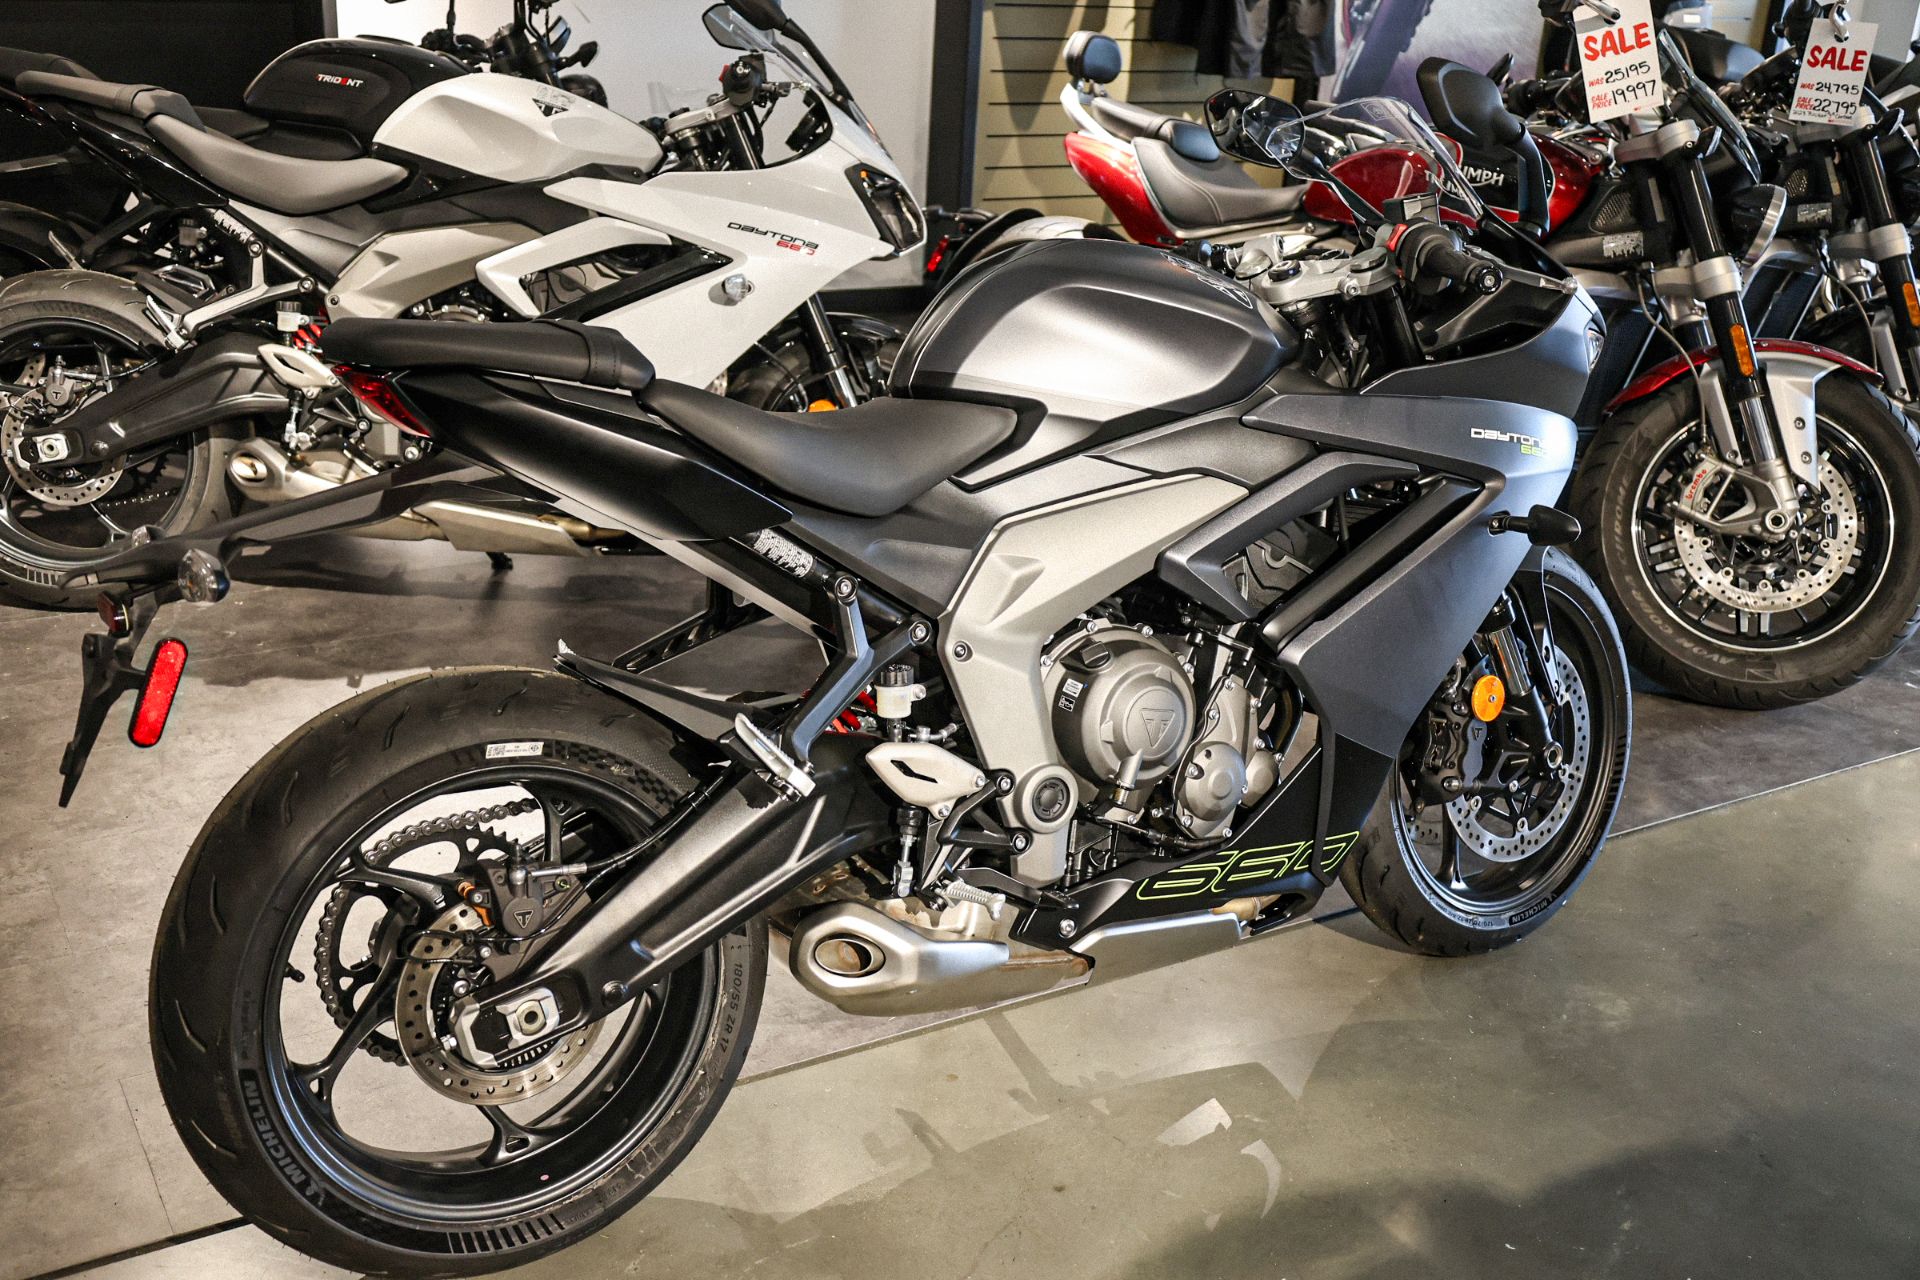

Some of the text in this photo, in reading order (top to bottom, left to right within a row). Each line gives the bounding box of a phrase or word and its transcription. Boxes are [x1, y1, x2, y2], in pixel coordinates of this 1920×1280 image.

[1584, 23, 1651, 61] SALE
[1807, 45, 1868, 72] SALE
[1589, 77, 1604, 87] WAS
[1800, 82, 1815, 90] WAS
[1592, 99, 1613, 110] PRICE
[1685, 469, 1707, 499] brembo
[1675, 636, 1736, 666] AVON
[1136, 831, 1360, 900] 660
[1511, 899, 1549, 924] MICHELIN
[720, 962, 743, 1053] 180/55 ZR 17
[244, 1079, 306, 1185] MICHELIN
